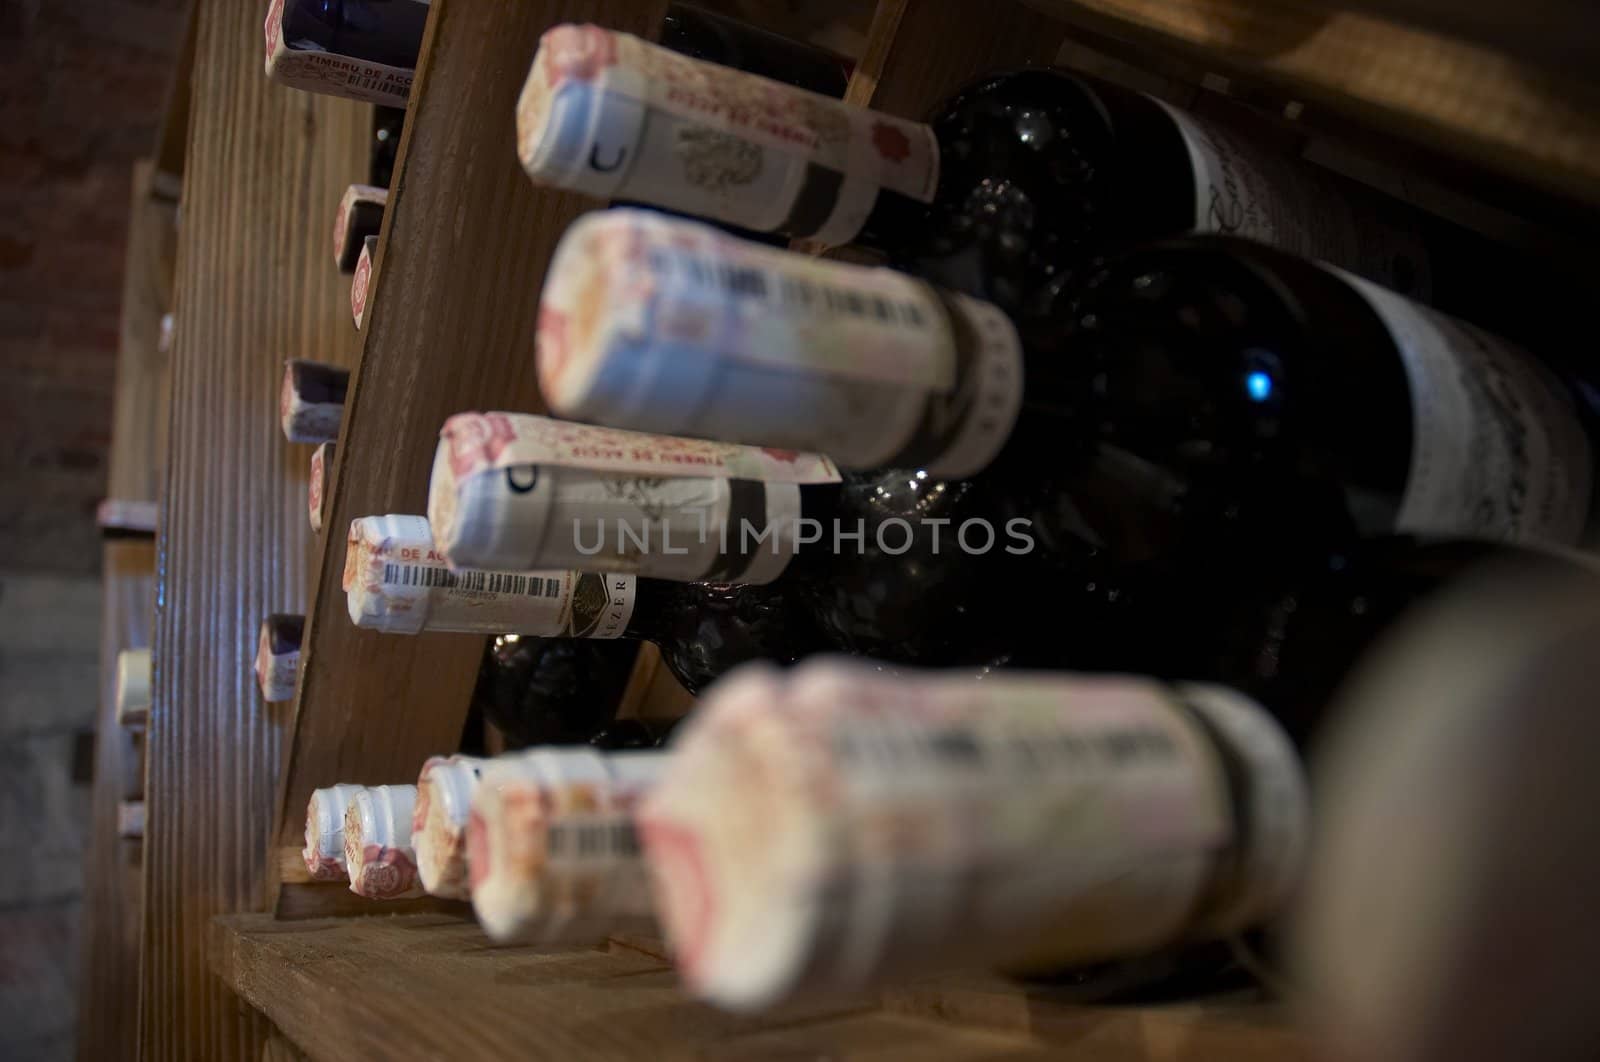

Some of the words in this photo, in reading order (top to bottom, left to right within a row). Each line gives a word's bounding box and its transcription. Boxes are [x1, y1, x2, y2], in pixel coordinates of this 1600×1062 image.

[307, 54, 360, 73] TIMBRU
[364, 68, 382, 79] DE
[400, 547, 420, 561] DE
